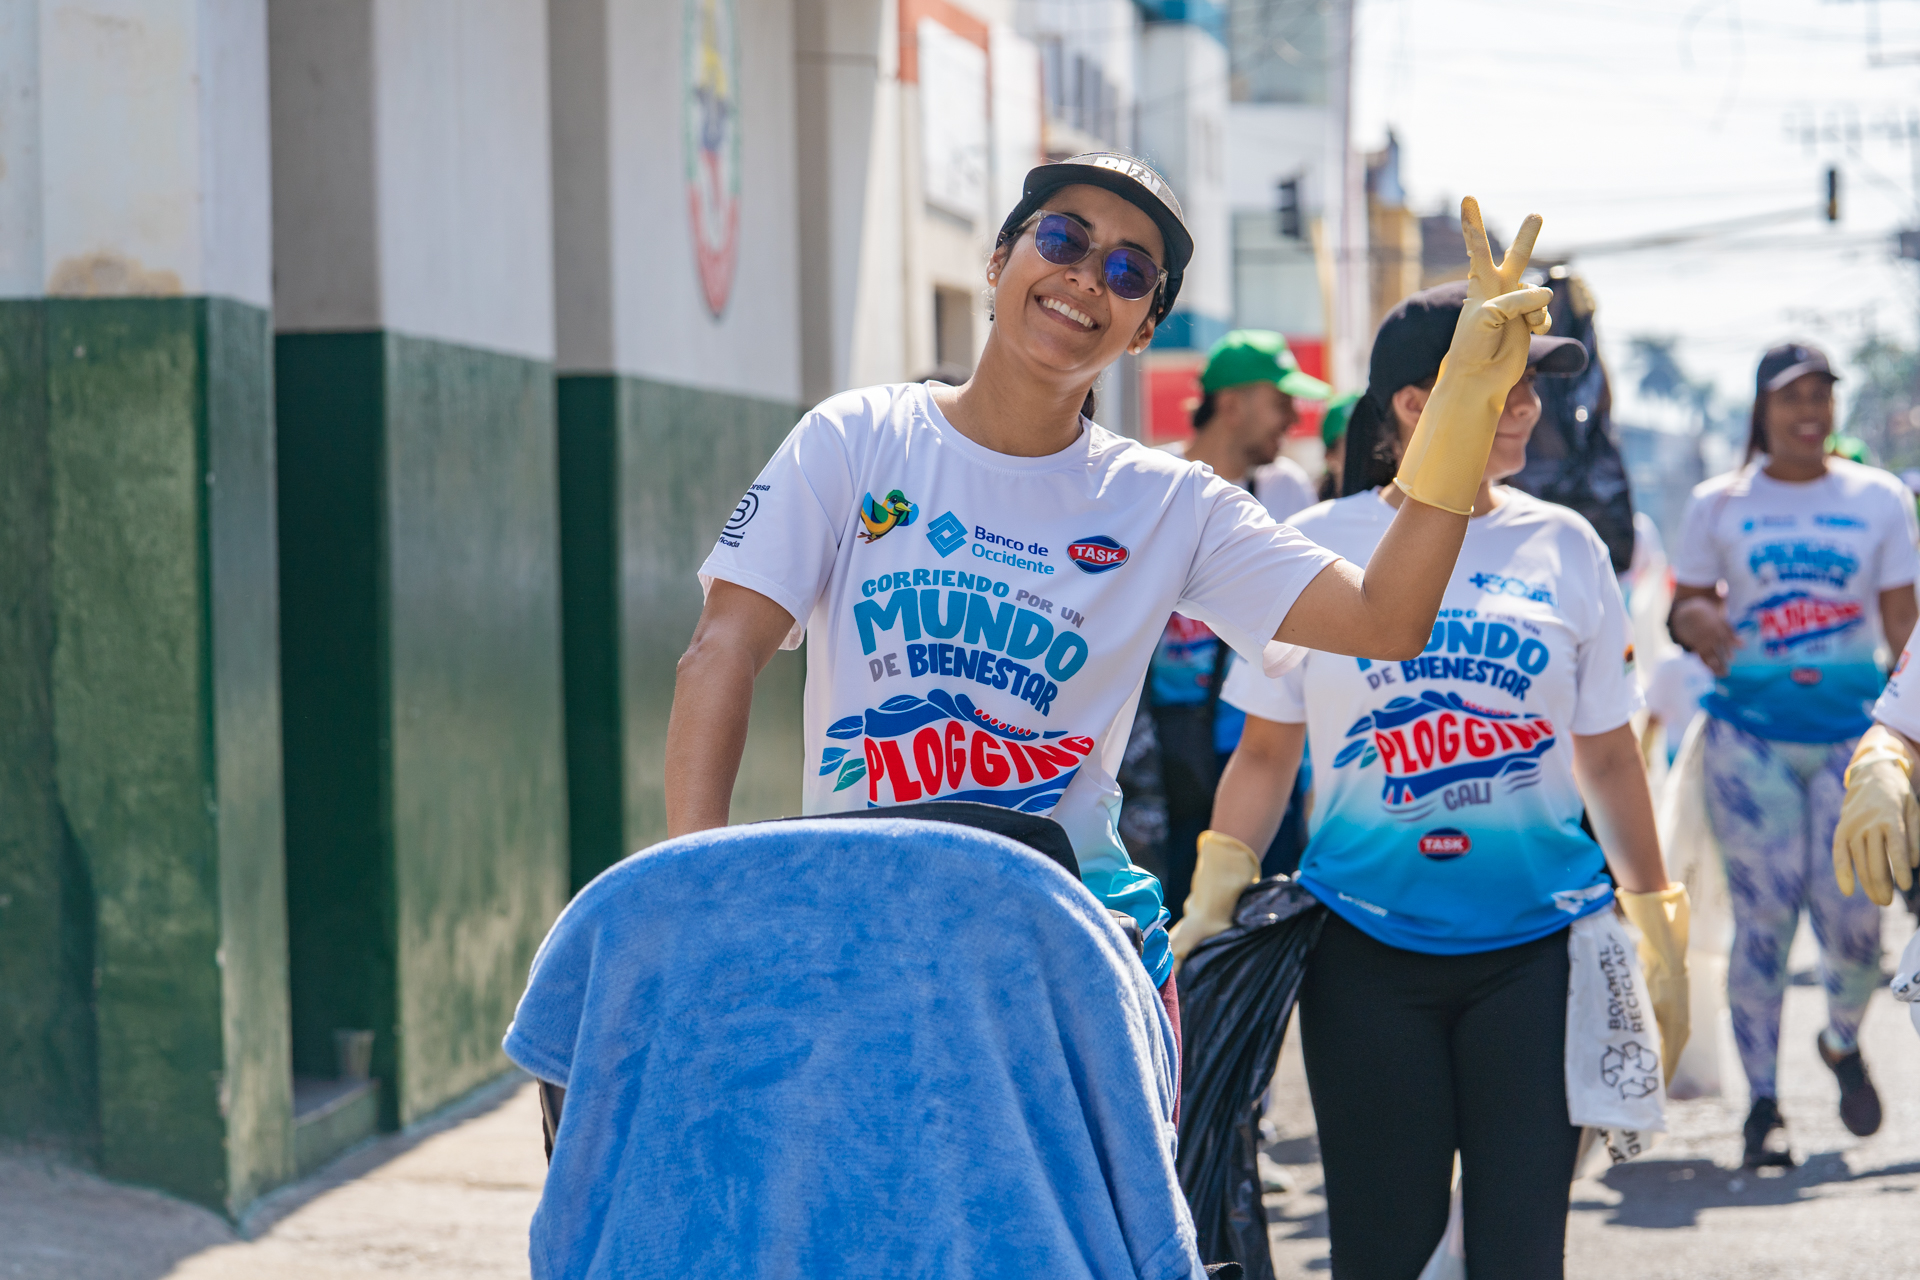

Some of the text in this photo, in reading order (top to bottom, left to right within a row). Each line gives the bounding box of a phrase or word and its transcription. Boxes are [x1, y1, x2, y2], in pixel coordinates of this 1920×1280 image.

[971, 543, 1055, 575] Occidente
[974, 525, 1049, 557] Banco de
[1074, 546, 1119, 562] TASK
[861, 568, 1085, 629] CORRIENDO POR UN
[853, 587, 1089, 682] MUNDO
[1521, 618, 1542, 636] UN
[868, 643, 1058, 717] DE BIENESTAR
[1366, 656, 1532, 702] DE BIENESTAR
[863, 720, 1095, 803] PLOGGING
[1374, 712, 1555, 775] PLOGGING
[1443, 781, 1492, 812] CALI
[1421, 838, 1465, 851] TASK
